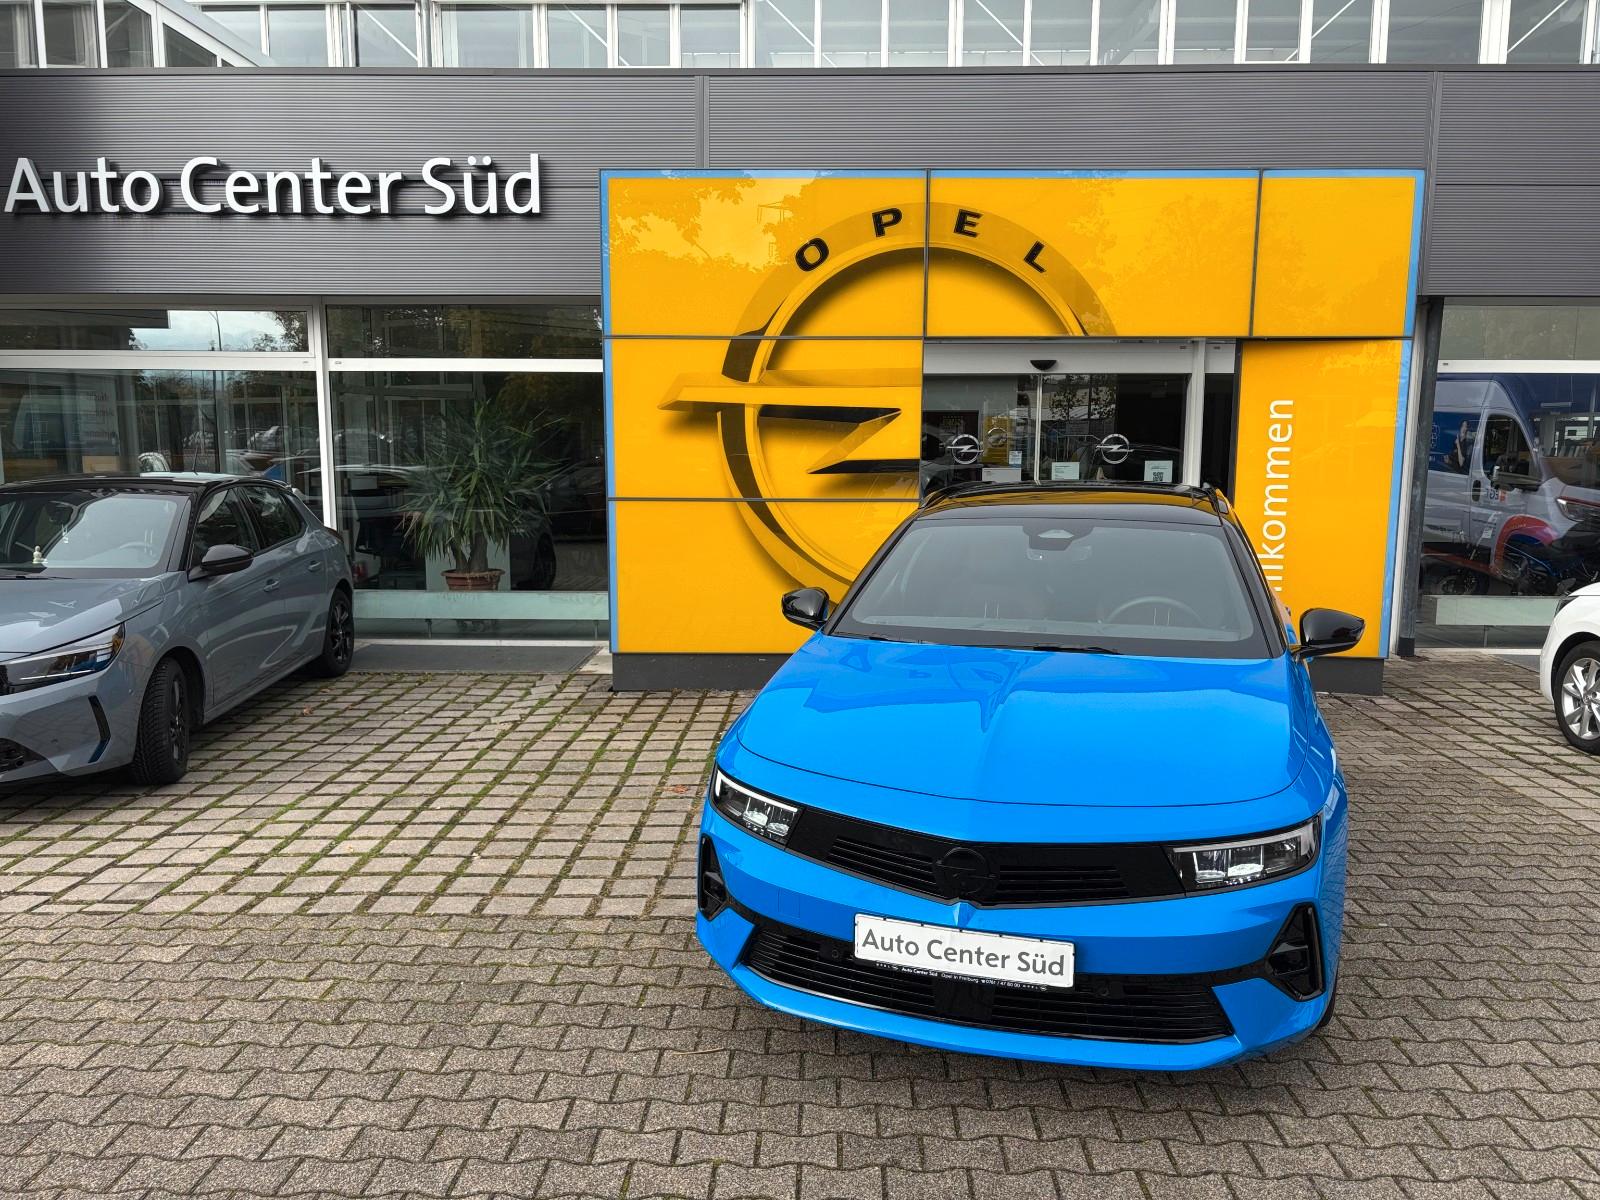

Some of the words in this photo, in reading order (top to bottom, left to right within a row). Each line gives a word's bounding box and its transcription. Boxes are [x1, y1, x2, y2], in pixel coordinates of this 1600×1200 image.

[4, 157, 161, 213] Auto
[180, 157, 403, 214] Center
[421, 153, 541, 215] Süd
[795, 207, 1047, 273] OPEL
[1255, 398, 1294, 592] lkommen
[862, 928, 920, 956] Auto
[927, 939, 1010, 969] Center
[1017, 951, 1065, 976] Süd
